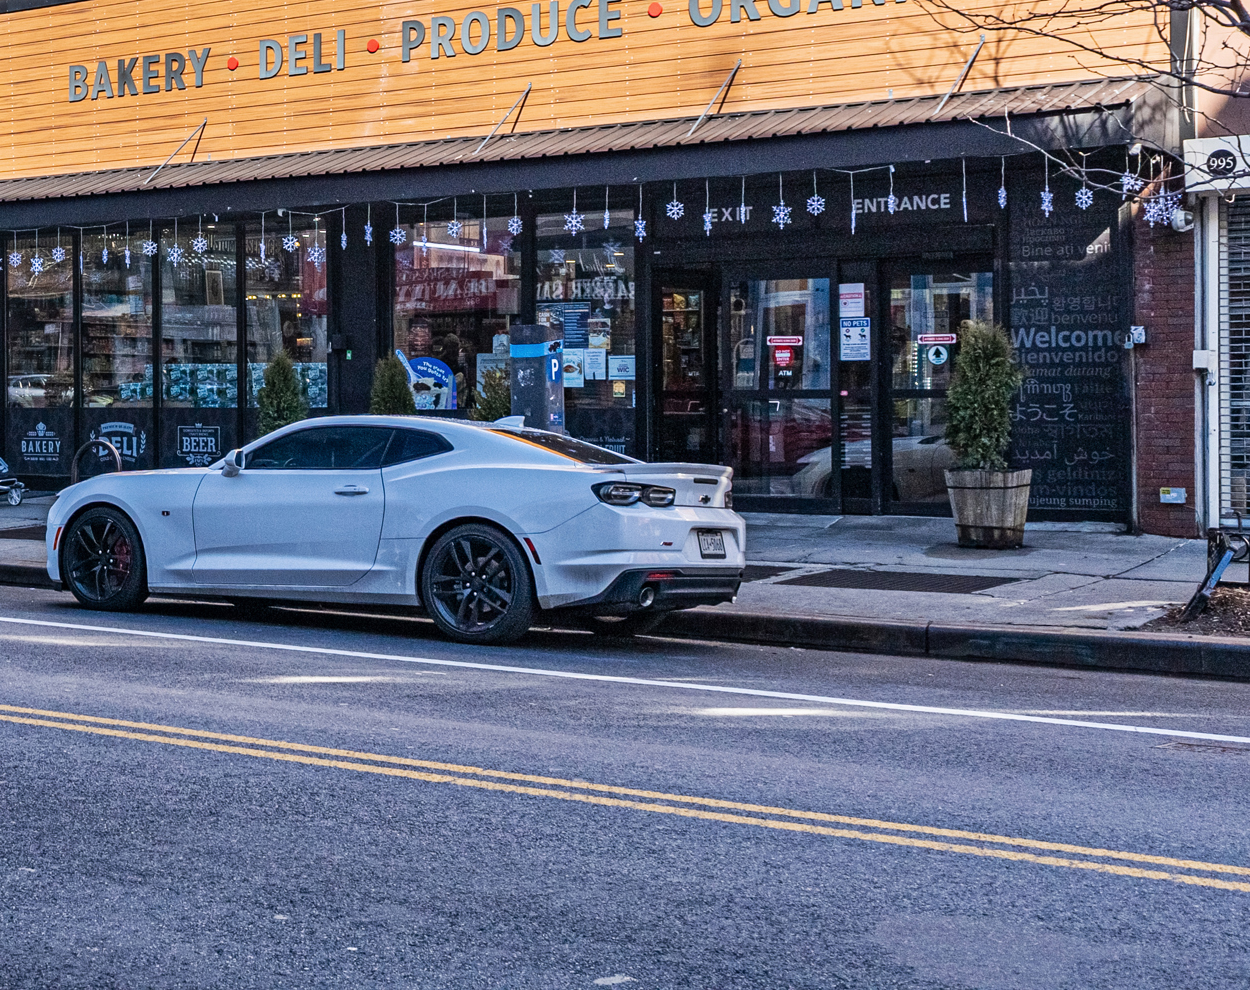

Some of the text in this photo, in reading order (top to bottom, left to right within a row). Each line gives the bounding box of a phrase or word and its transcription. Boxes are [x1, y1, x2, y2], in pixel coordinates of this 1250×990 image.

[68, 46, 212, 102] BAKERY
[259, 28, 347, 80] DELI
[1210, 156, 1234, 170] 995
[710, 206, 753, 223] EXIT
[853, 193, 951, 215] ENTRANCE
[1010, 325, 1125, 349] Welcome
[551, 358, 559, 380] P
[21, 440, 61, 453] BAKERY
[98, 436, 138, 458] DELI
[182, 436, 217, 453] BEER
